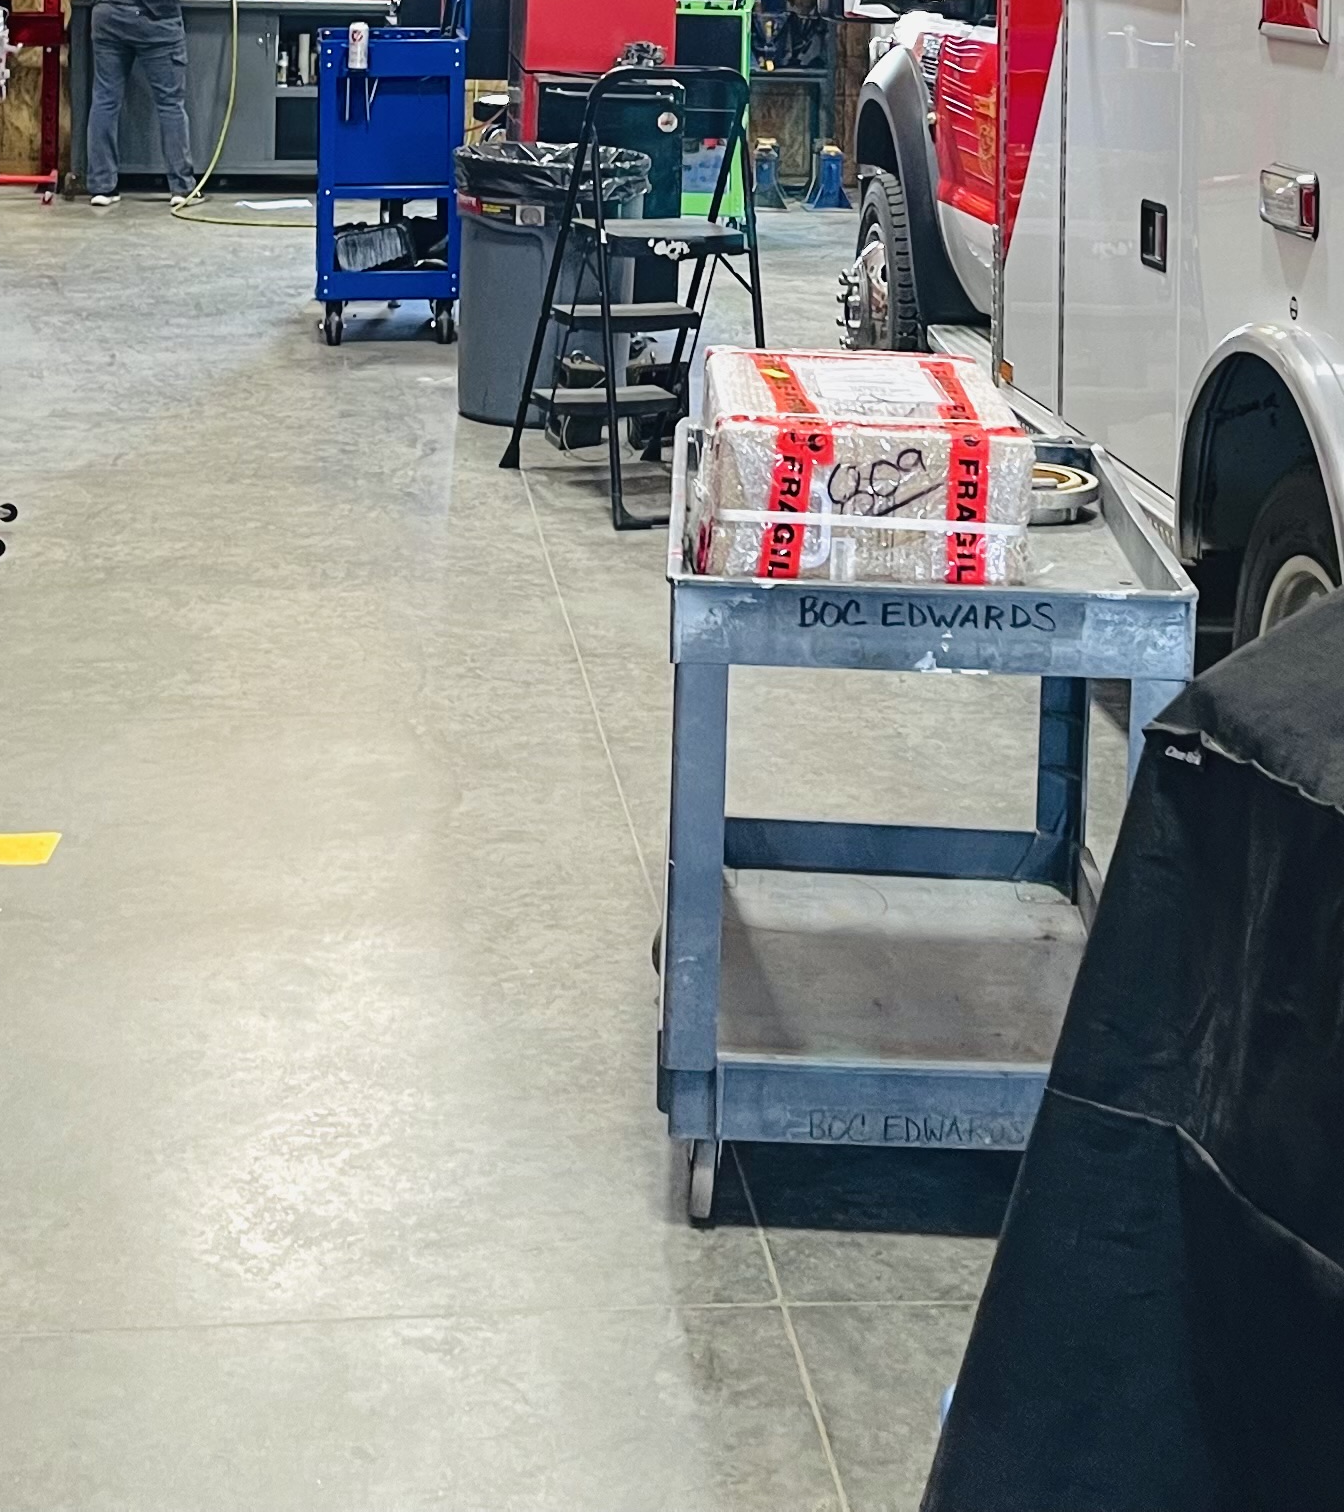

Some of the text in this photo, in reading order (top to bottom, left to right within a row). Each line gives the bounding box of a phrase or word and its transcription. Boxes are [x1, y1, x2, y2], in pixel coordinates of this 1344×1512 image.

[799, 597, 1058, 633] BOC EDWARDS
[808, 1108, 1025, 1145] BOC EDWARDS
